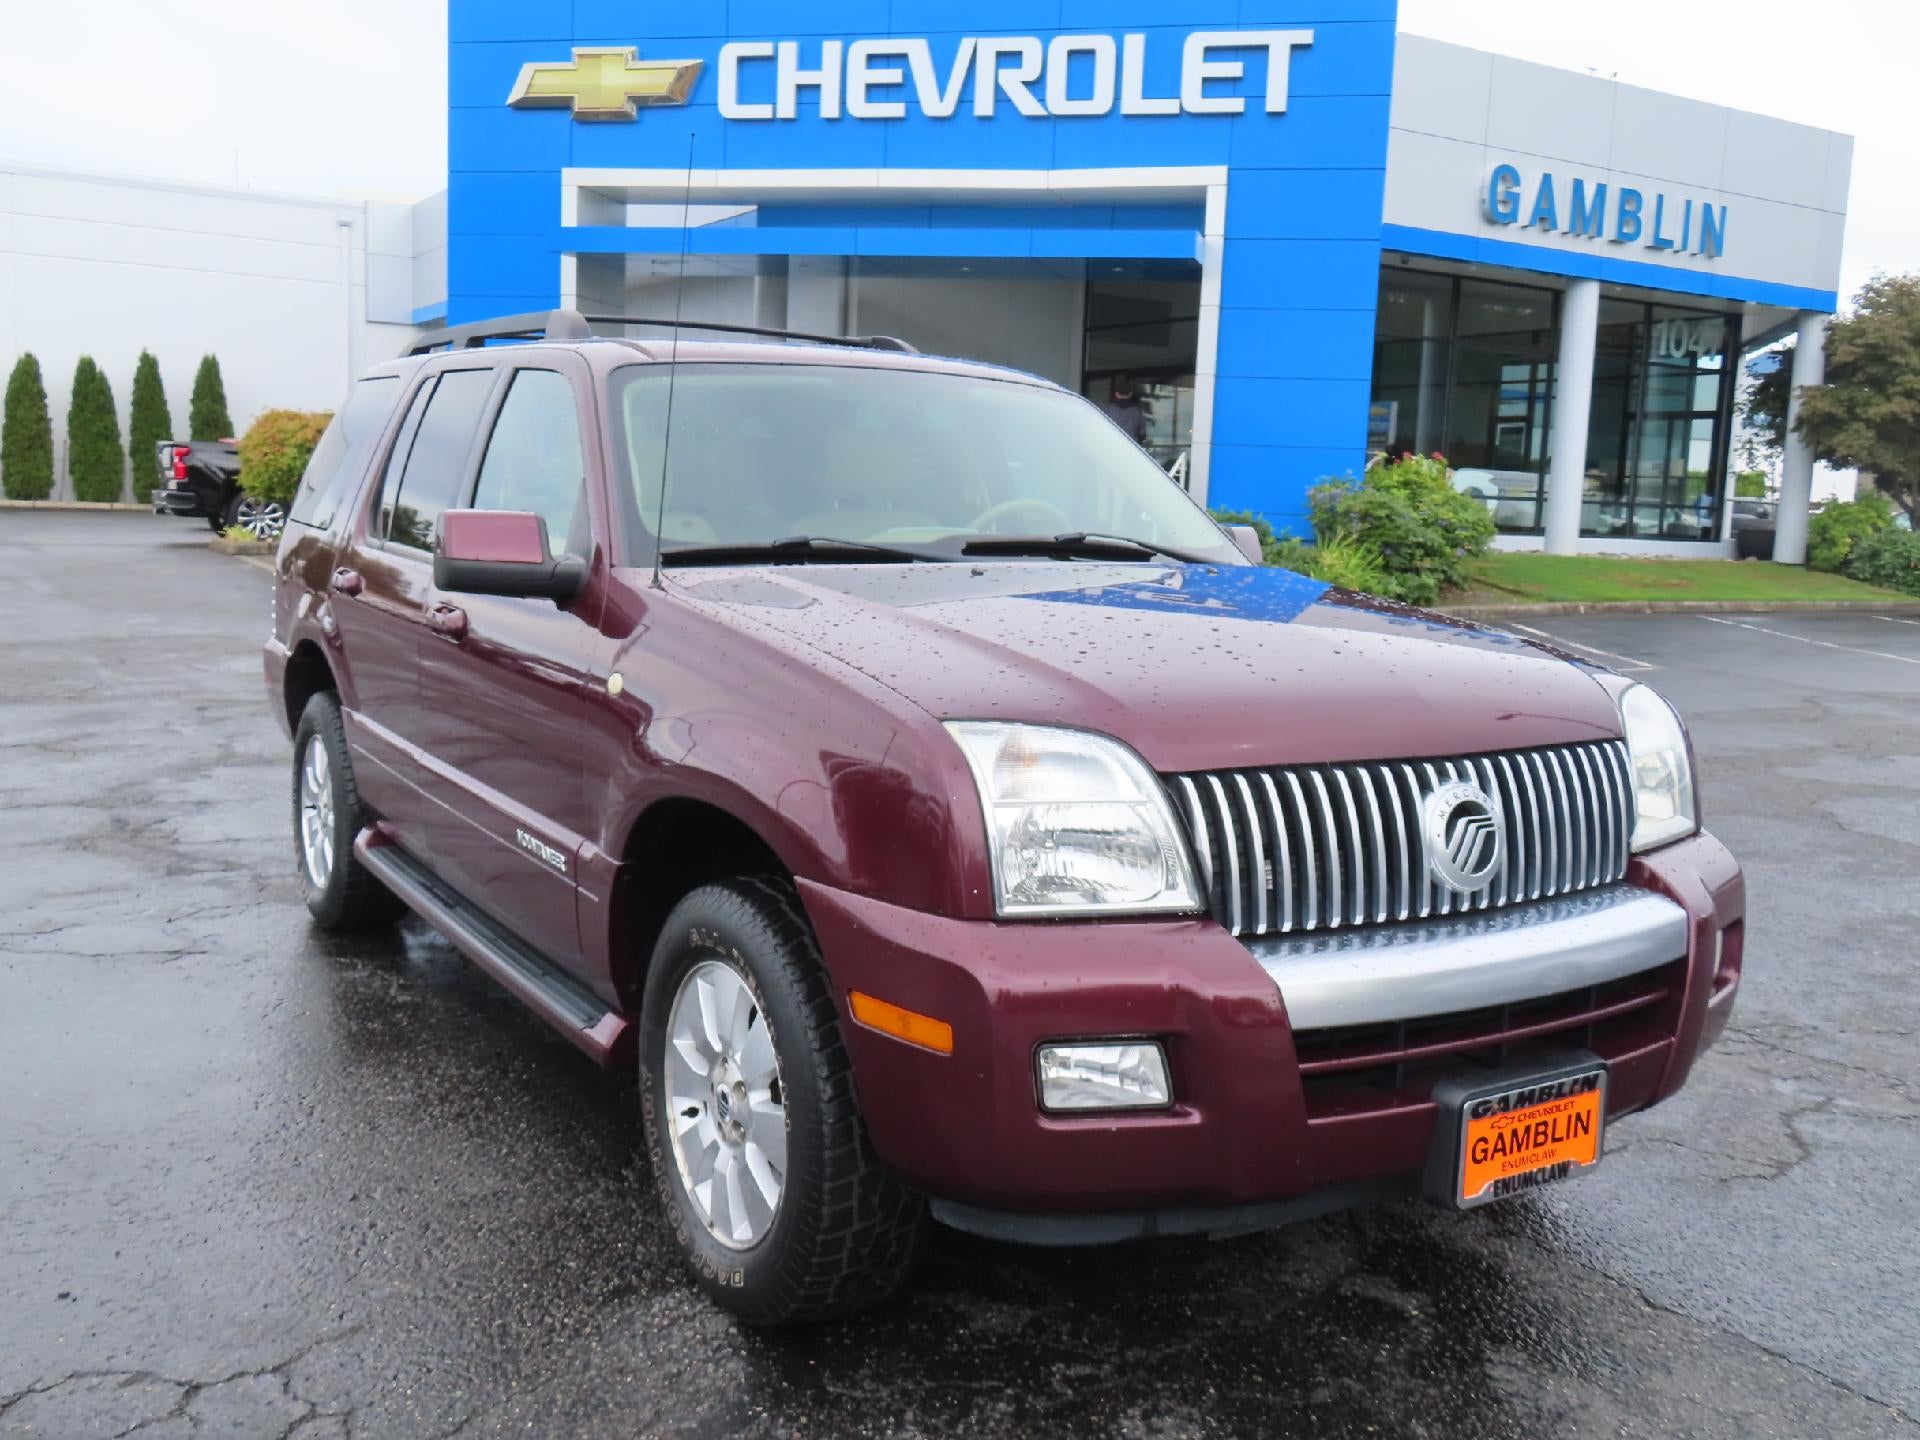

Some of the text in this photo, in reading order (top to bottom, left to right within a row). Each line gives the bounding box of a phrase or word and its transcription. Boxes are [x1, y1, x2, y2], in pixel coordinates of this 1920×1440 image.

[717, 29, 1315, 119] CHEVROLET
[1487, 163, 1728, 258] GAMBLIN
[1471, 1073, 1600, 1120] GAMBLIN
[1517, 1100, 1576, 1123] CHEVROLET
[1471, 1109, 1592, 1165] GAMBLIN
[1501, 1148, 1557, 1172] ENUMCLAW
[1493, 1160, 1570, 1198] ENUMCLAW
